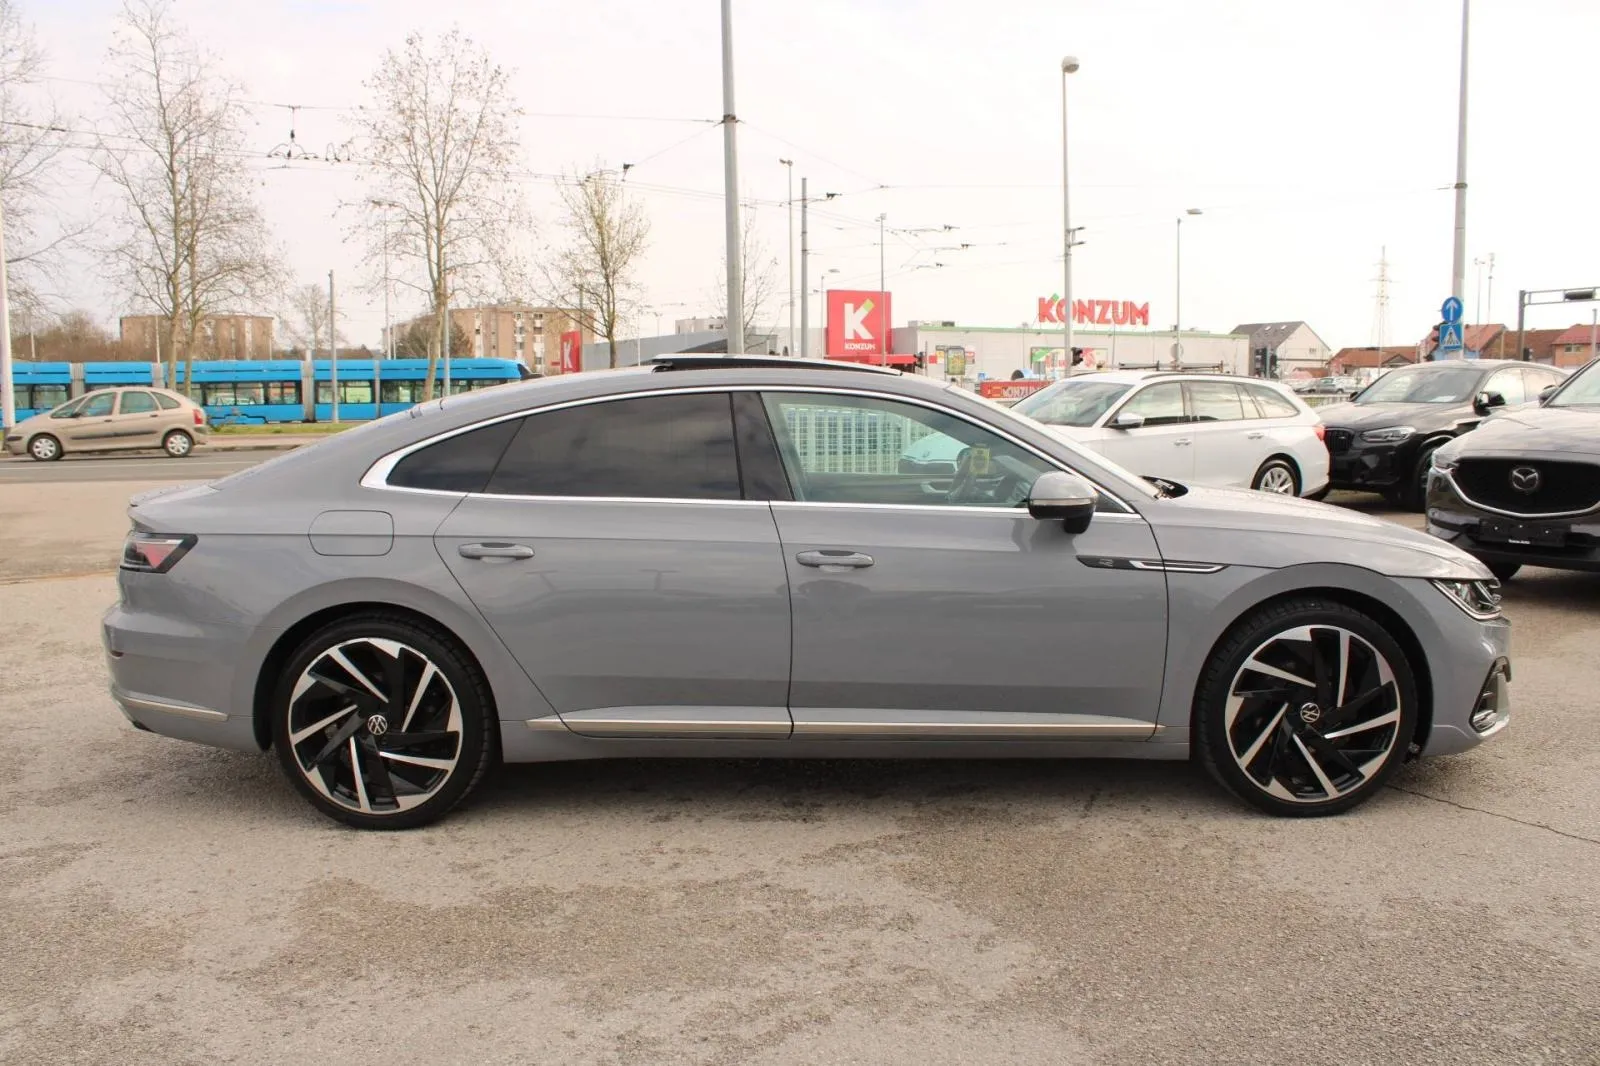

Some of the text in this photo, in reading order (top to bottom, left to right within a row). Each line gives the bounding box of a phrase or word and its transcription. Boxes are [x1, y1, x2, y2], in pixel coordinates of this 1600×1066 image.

[844, 298, 875, 340] K
[1038, 293, 1149, 325] KONZUM
[844, 342, 876, 351] KONZUM
